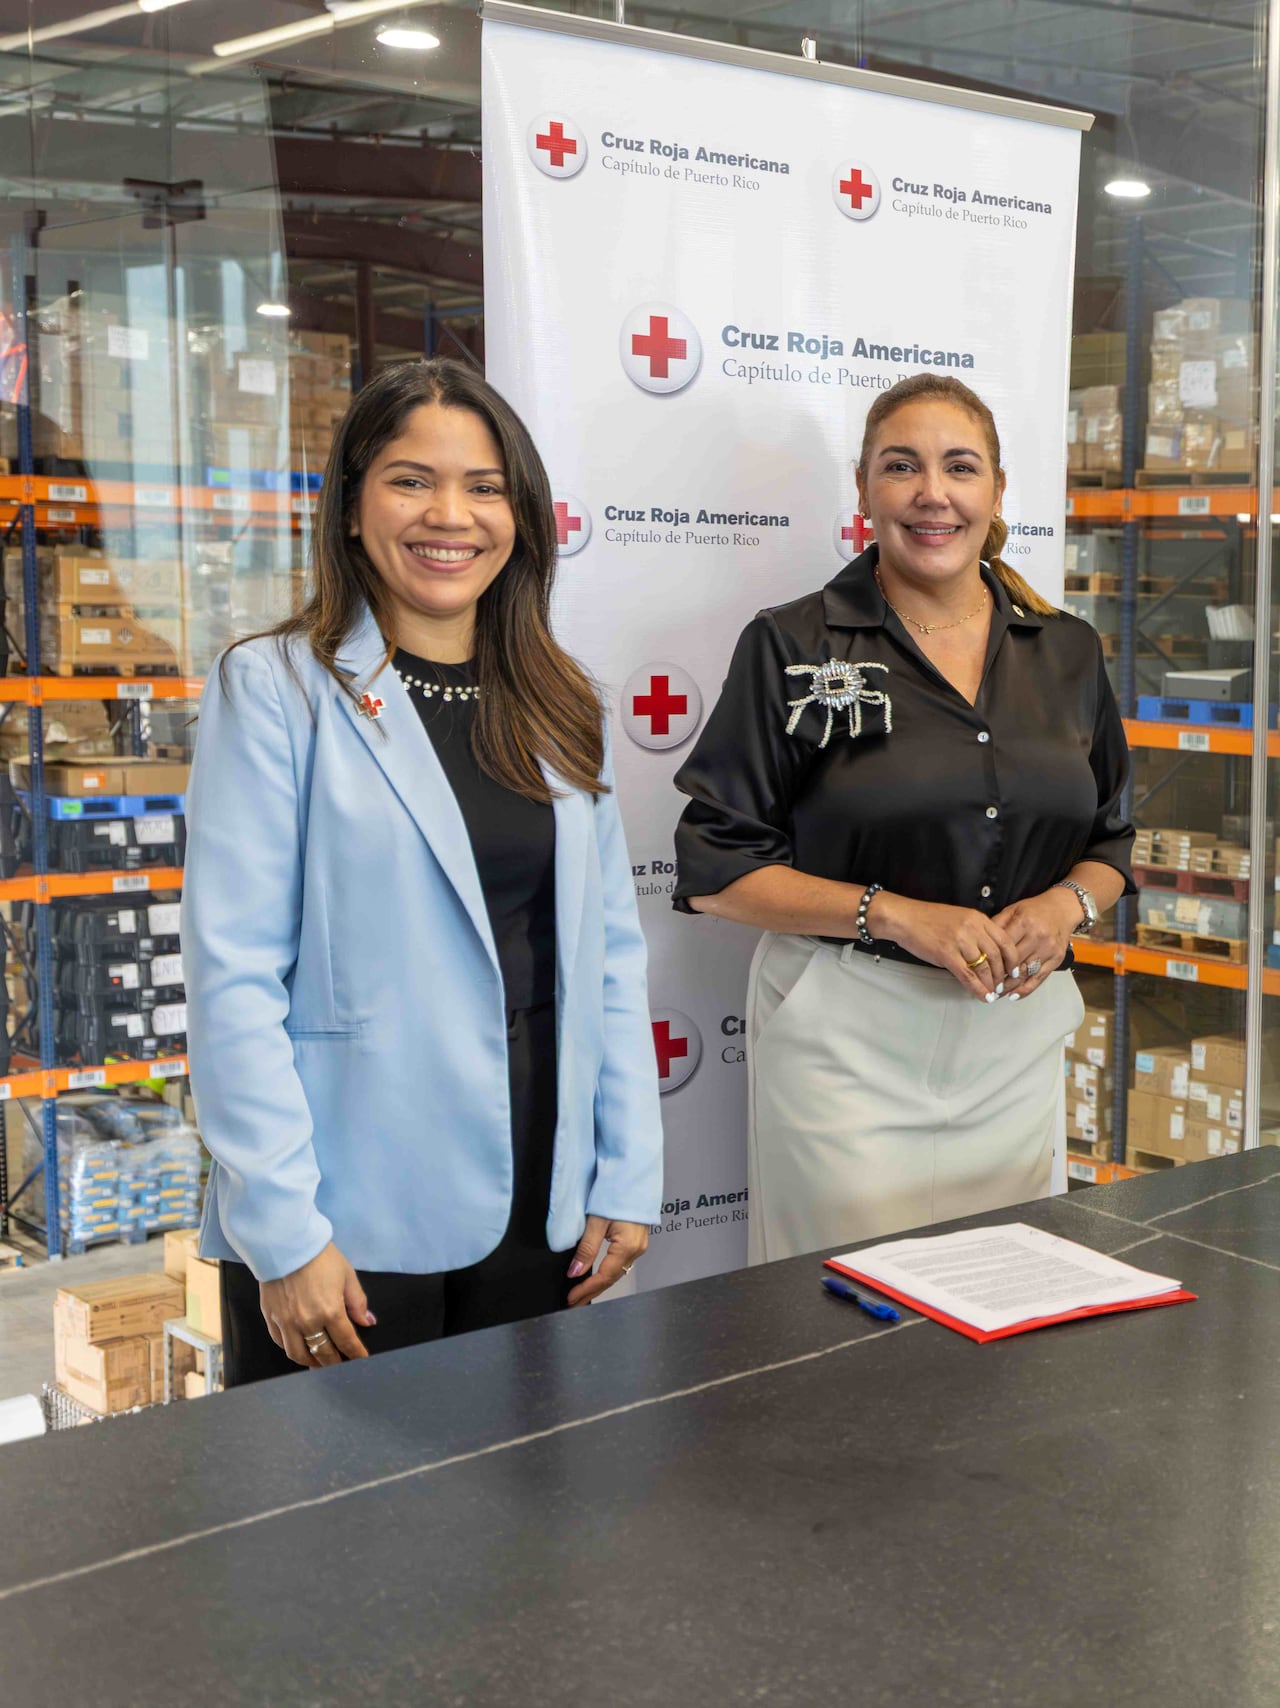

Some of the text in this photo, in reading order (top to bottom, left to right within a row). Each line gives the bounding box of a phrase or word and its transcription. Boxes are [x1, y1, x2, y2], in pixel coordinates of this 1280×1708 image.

[601, 131, 791, 174] Cruz Roja Americana
[601, 155, 760, 191] Capítulo de Puerto Rico
[892, 177, 1053, 214] Cruz Roja Americana
[892, 199, 1028, 229] Capítulo de Puerto Rico
[721, 325, 975, 369] Cruz Roja Americana
[722, 358, 802, 385] Capítulo
[808, 366, 832, 384] de
[837, 368, 892, 389] Puerto
[604, 505, 790, 527] Cruz Roja Americana
[605, 528, 760, 546] Capítulo de Puerto Rico
[1007, 542, 1031, 555] Rico
[696, 1187, 748, 1208] Ameri
[666, 1219, 682, 1233] de
[686, 1213, 728, 1229] Puerto
